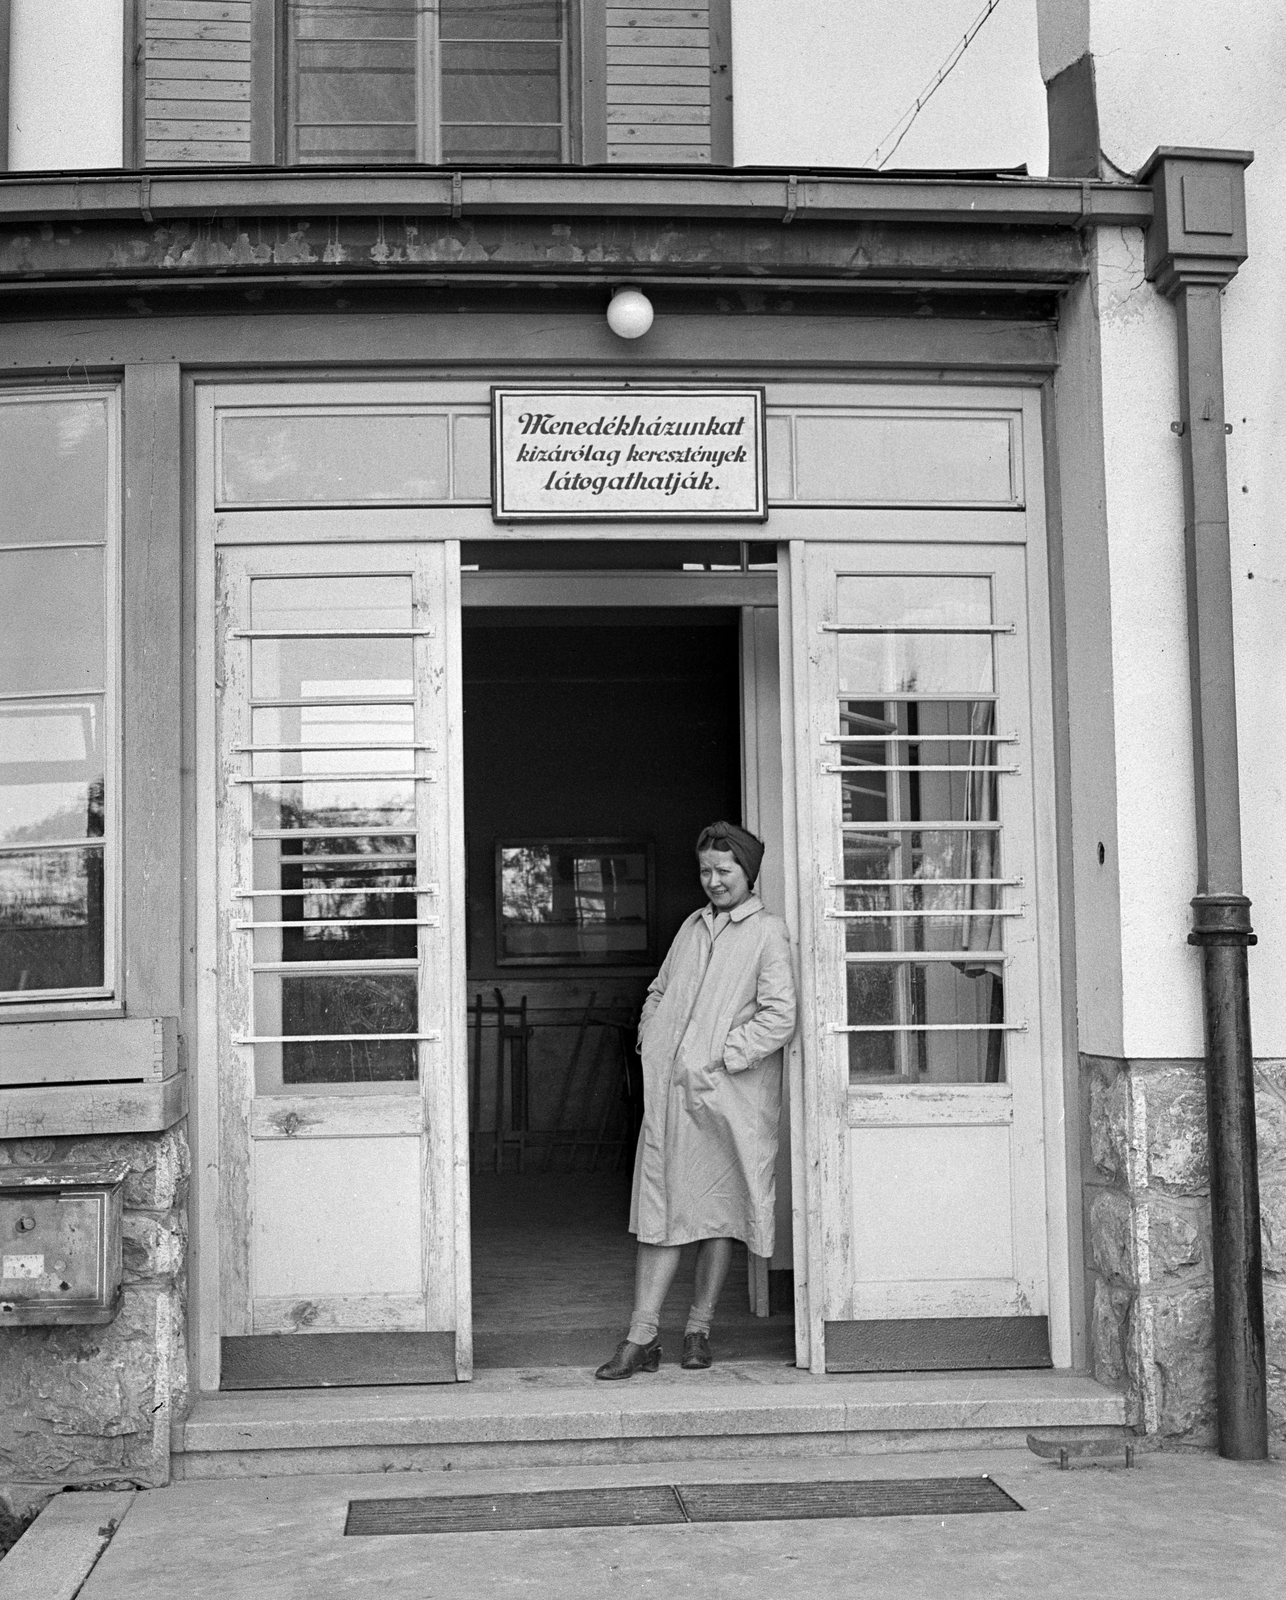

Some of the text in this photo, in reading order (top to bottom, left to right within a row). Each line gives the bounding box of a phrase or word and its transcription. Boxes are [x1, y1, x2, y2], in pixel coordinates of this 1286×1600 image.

[517, 412, 746, 436] Menedékházunkat
[516, 443, 747, 467] kizárólag keresztények
[543, 470, 720, 495] látogathatják.
